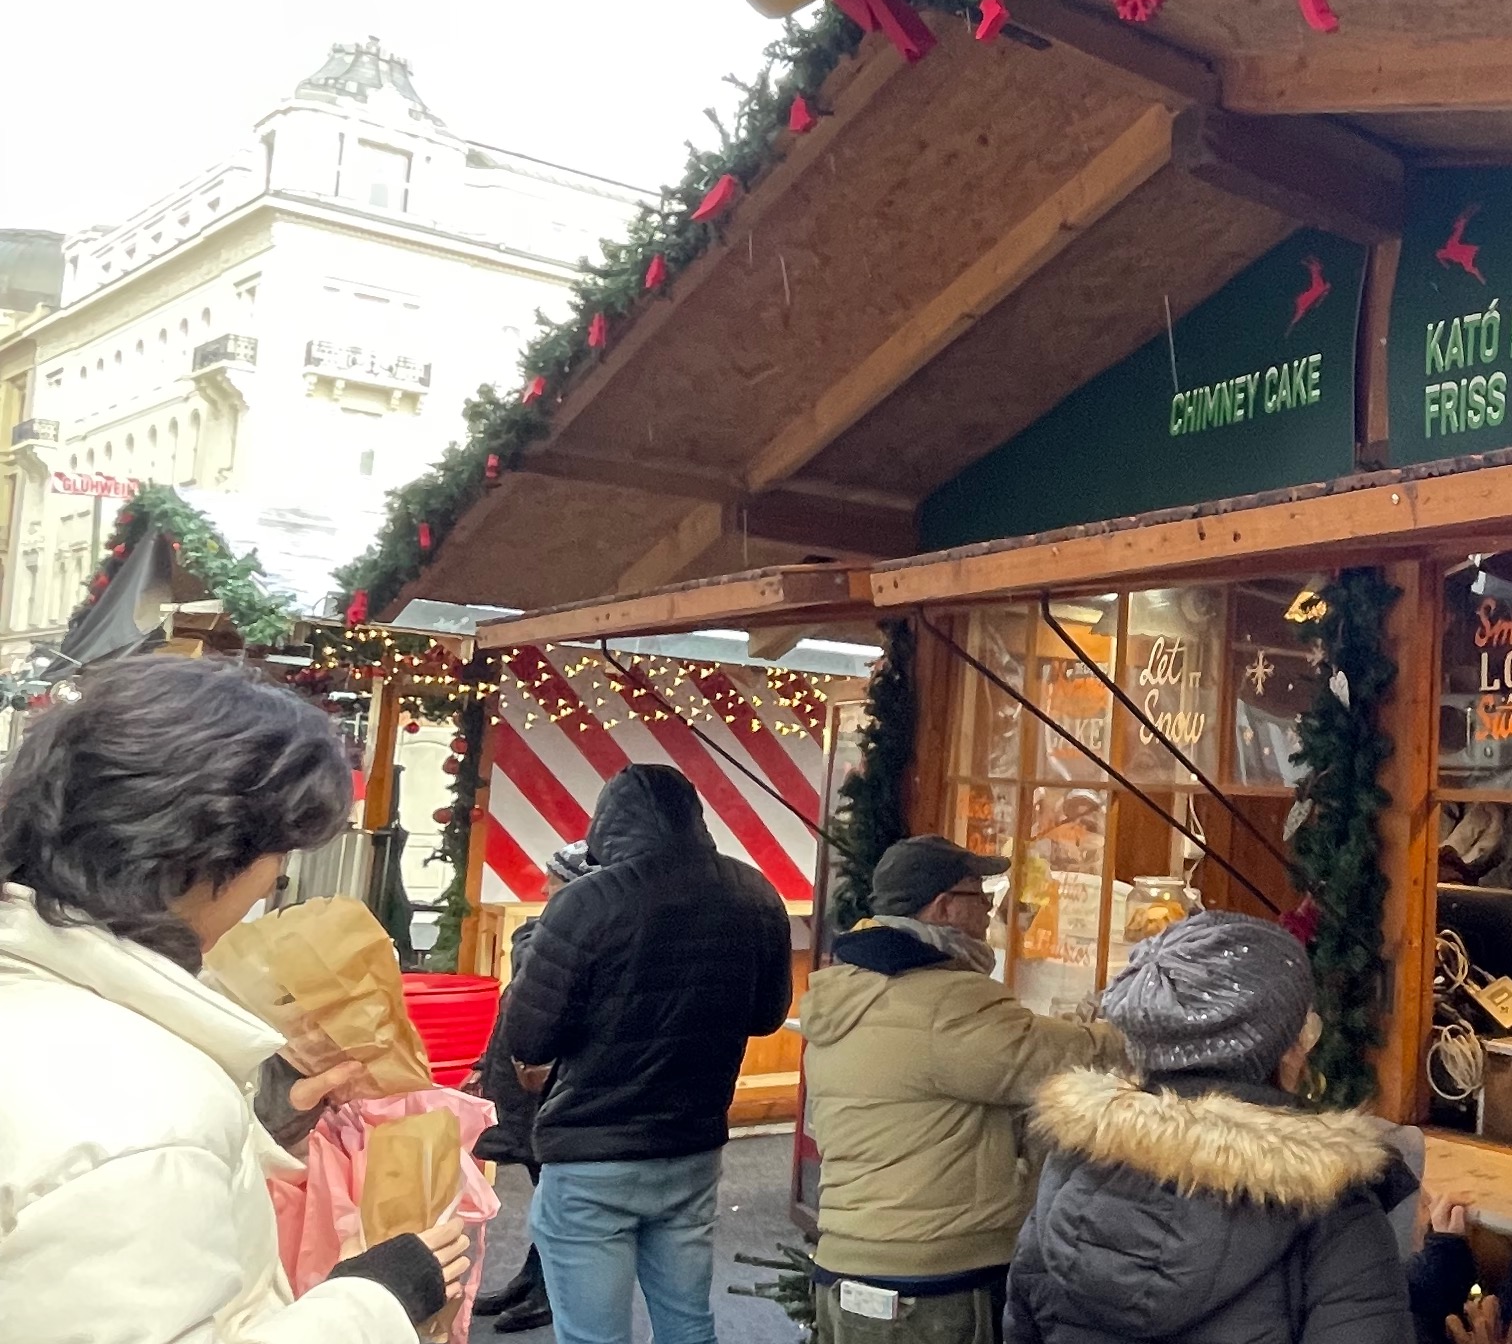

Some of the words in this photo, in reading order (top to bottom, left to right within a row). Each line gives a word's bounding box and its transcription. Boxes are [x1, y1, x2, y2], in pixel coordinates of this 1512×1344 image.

[1425, 298, 1500, 375] KATÓ
[1169, 371, 1260, 437] CHIMNEY
[1264, 353, 1322, 414] CAKE
[1424, 371, 1507, 438] FRISS
[1139, 636, 1188, 687] Let
[1139, 688, 1205, 746] Snow
